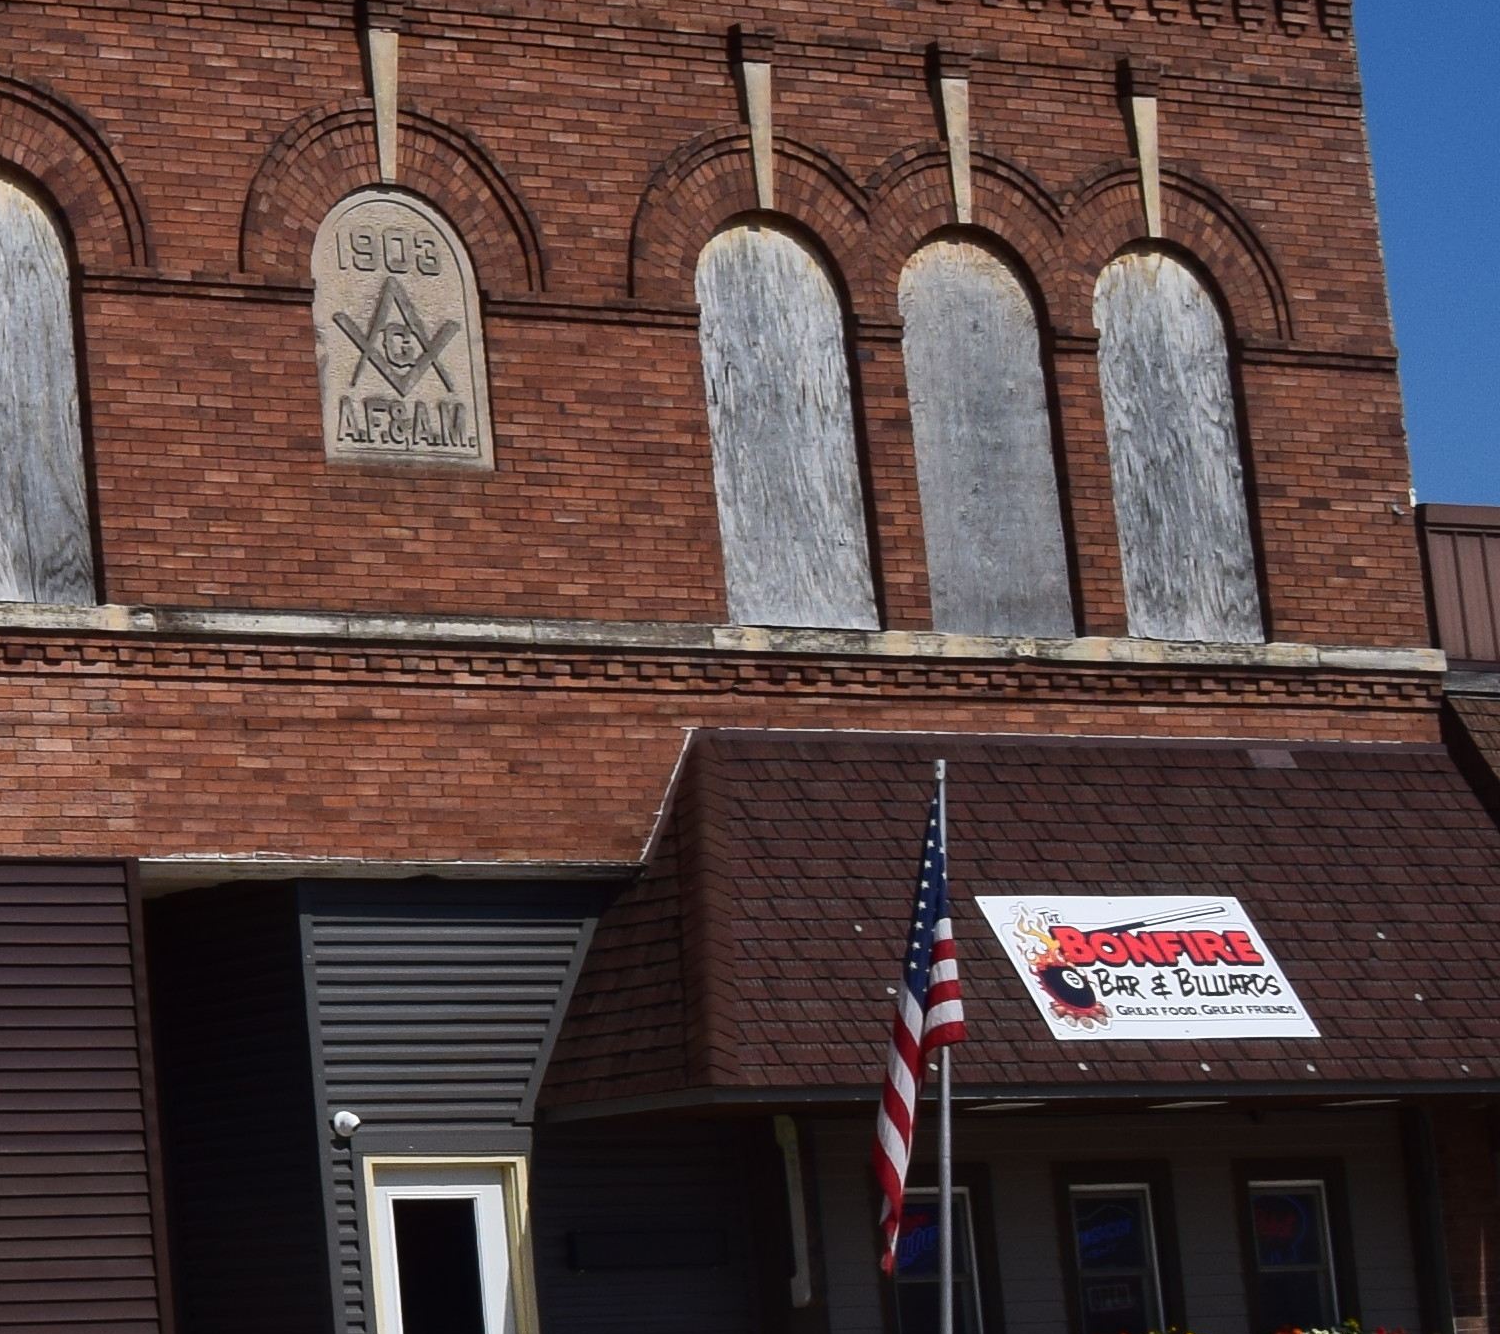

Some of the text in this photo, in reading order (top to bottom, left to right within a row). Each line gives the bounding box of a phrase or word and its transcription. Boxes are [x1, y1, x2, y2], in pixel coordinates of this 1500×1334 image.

[335, 224, 442, 276] 1903
[1038, 911, 1061, 926] THE
[1048, 925, 1264, 968] BONFIRE
[1092, 967, 1283, 1000] BAR & BILLIARDS
[1115, 1004, 1160, 1016] GREAT
[1245, 1005, 1297, 1015] FRIENDS
